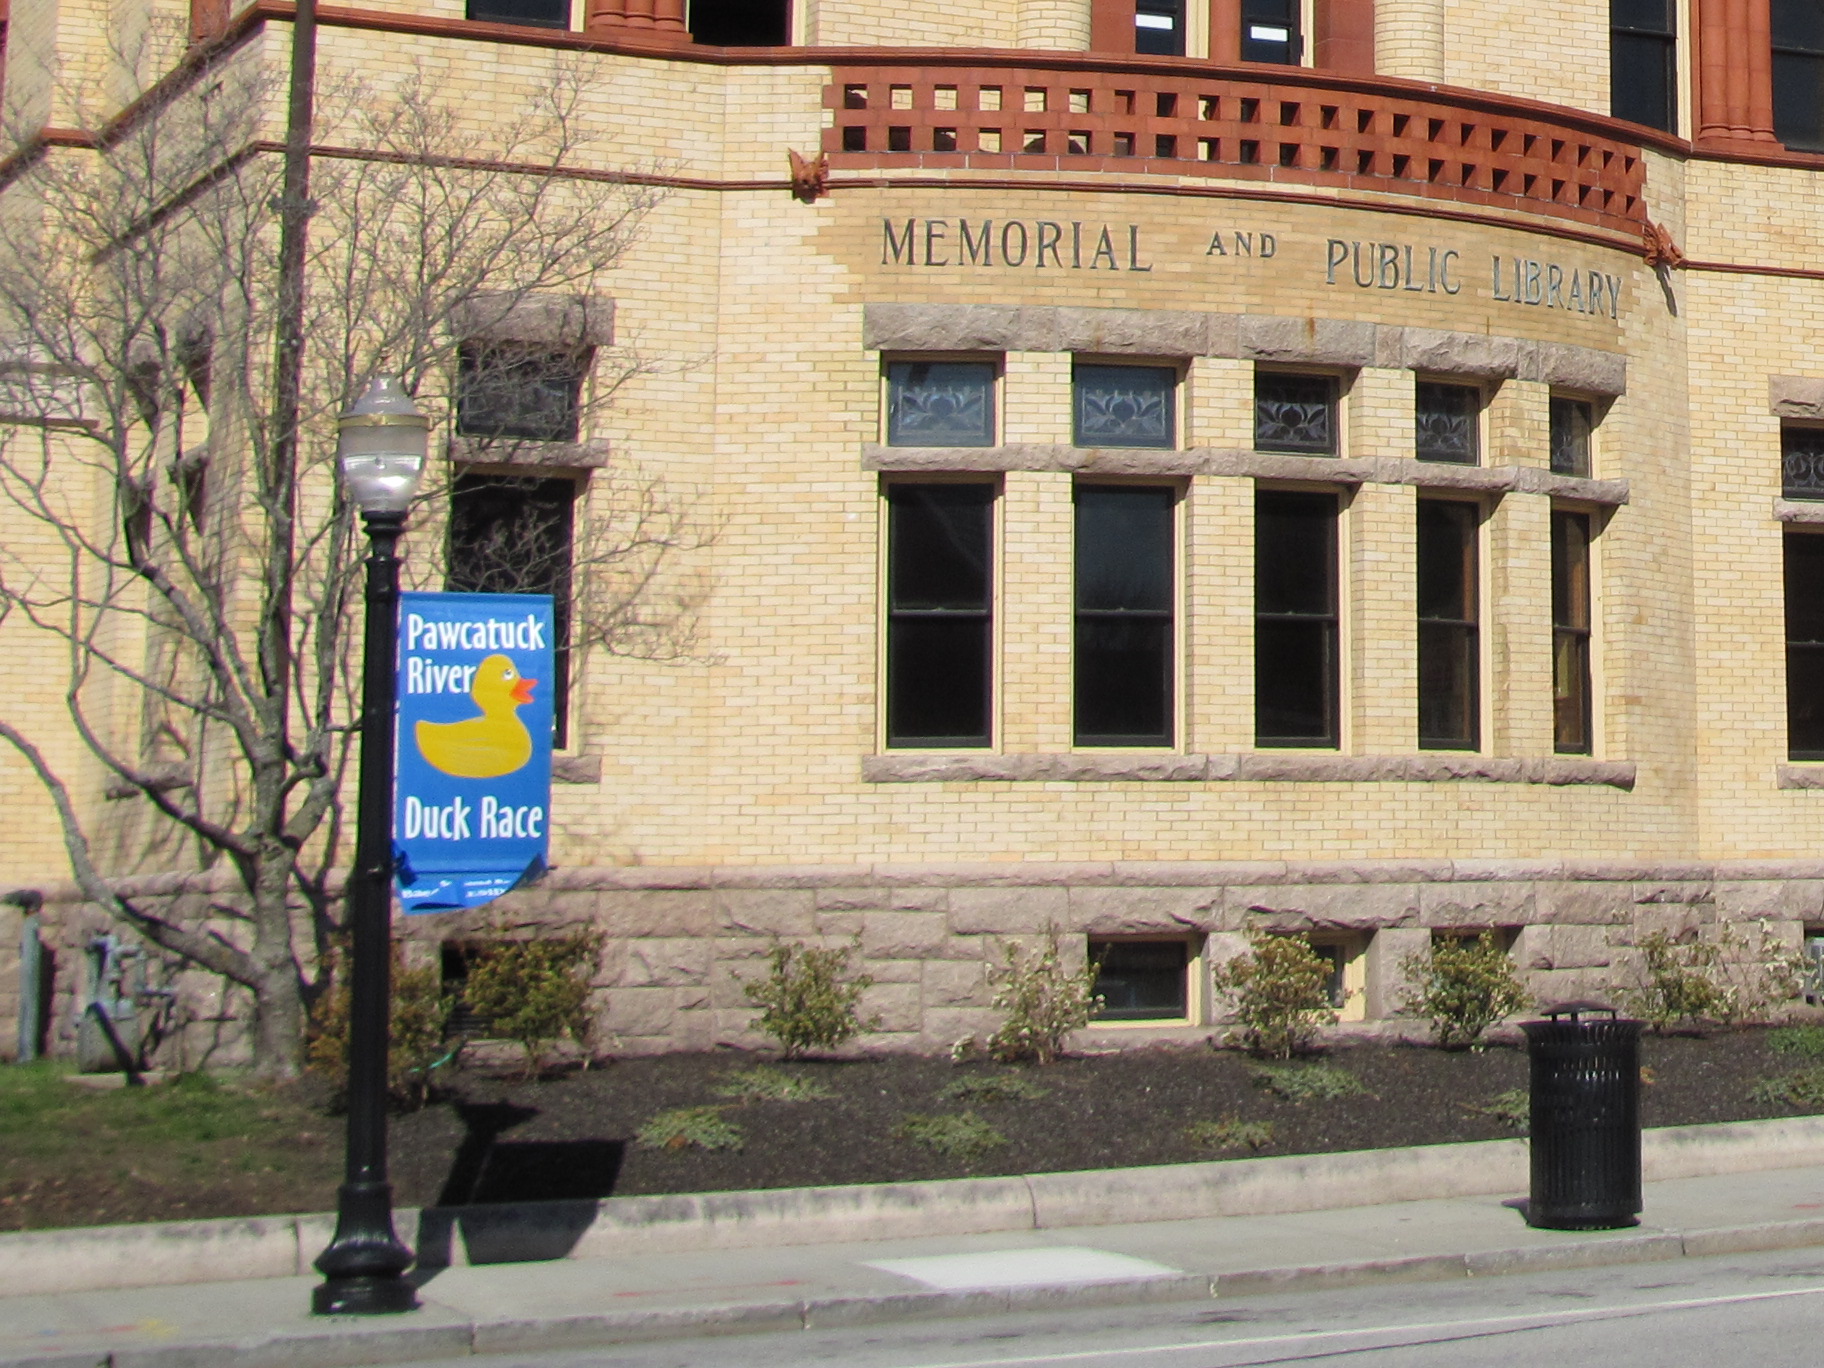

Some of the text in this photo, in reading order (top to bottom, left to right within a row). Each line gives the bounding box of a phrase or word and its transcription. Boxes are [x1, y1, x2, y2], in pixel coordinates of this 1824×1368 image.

[881, 216, 1623, 320] MEMORIAL AND PUBLIC LIBRARY
[407, 613, 546, 651] Pawcatuck
[407, 656, 477, 694] River
[404, 795, 543, 841] Duck Race
